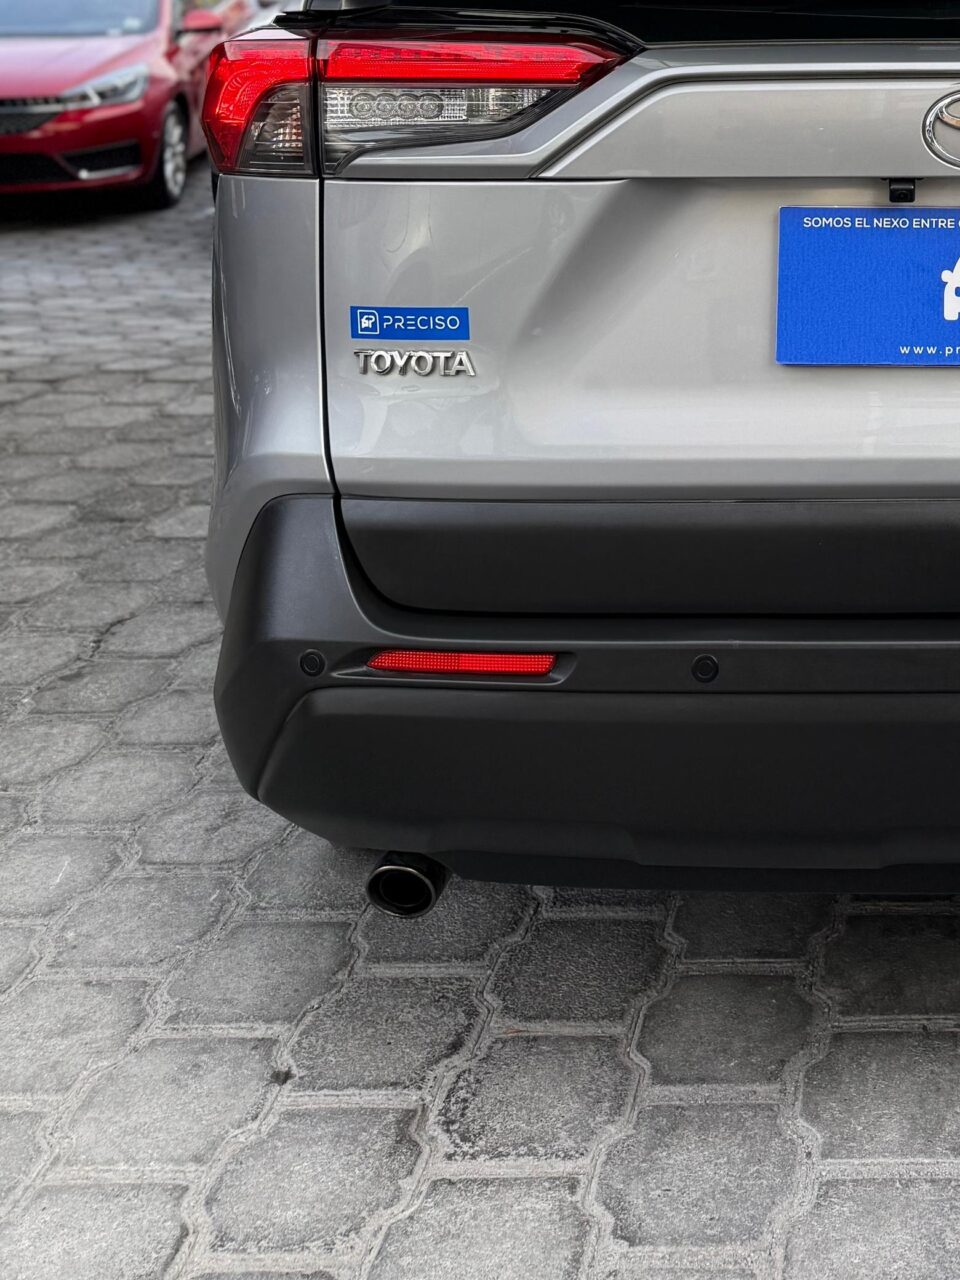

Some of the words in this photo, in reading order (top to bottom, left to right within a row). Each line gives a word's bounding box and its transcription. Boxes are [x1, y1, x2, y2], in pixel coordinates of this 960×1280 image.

[803, 217, 852, 228] SOMOS
[855, 218, 871, 228] EL
[873, 218, 909, 229] NEXO
[912, 218, 955, 229] ENTRE
[383, 315, 460, 330] PRECISO
[353, 349, 477, 377] TOYOTA
